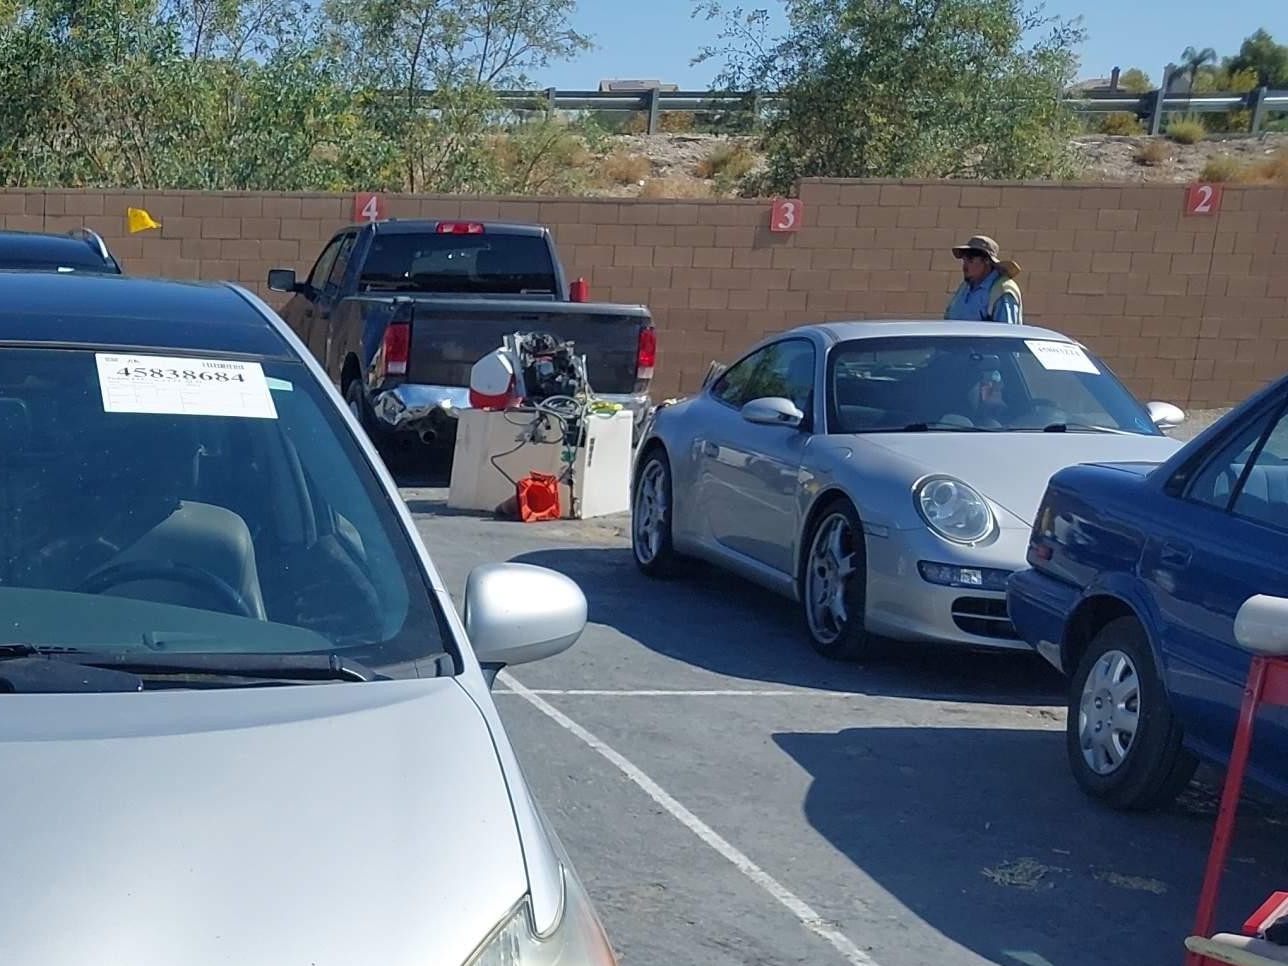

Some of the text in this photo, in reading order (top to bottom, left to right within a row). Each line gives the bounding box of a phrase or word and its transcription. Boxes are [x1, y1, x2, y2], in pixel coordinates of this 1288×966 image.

[362, 196, 378, 222] 4
[1194, 186, 1212, 212] 2
[778, 203, 795, 229] 3
[116, 367, 246, 383] 45838684
